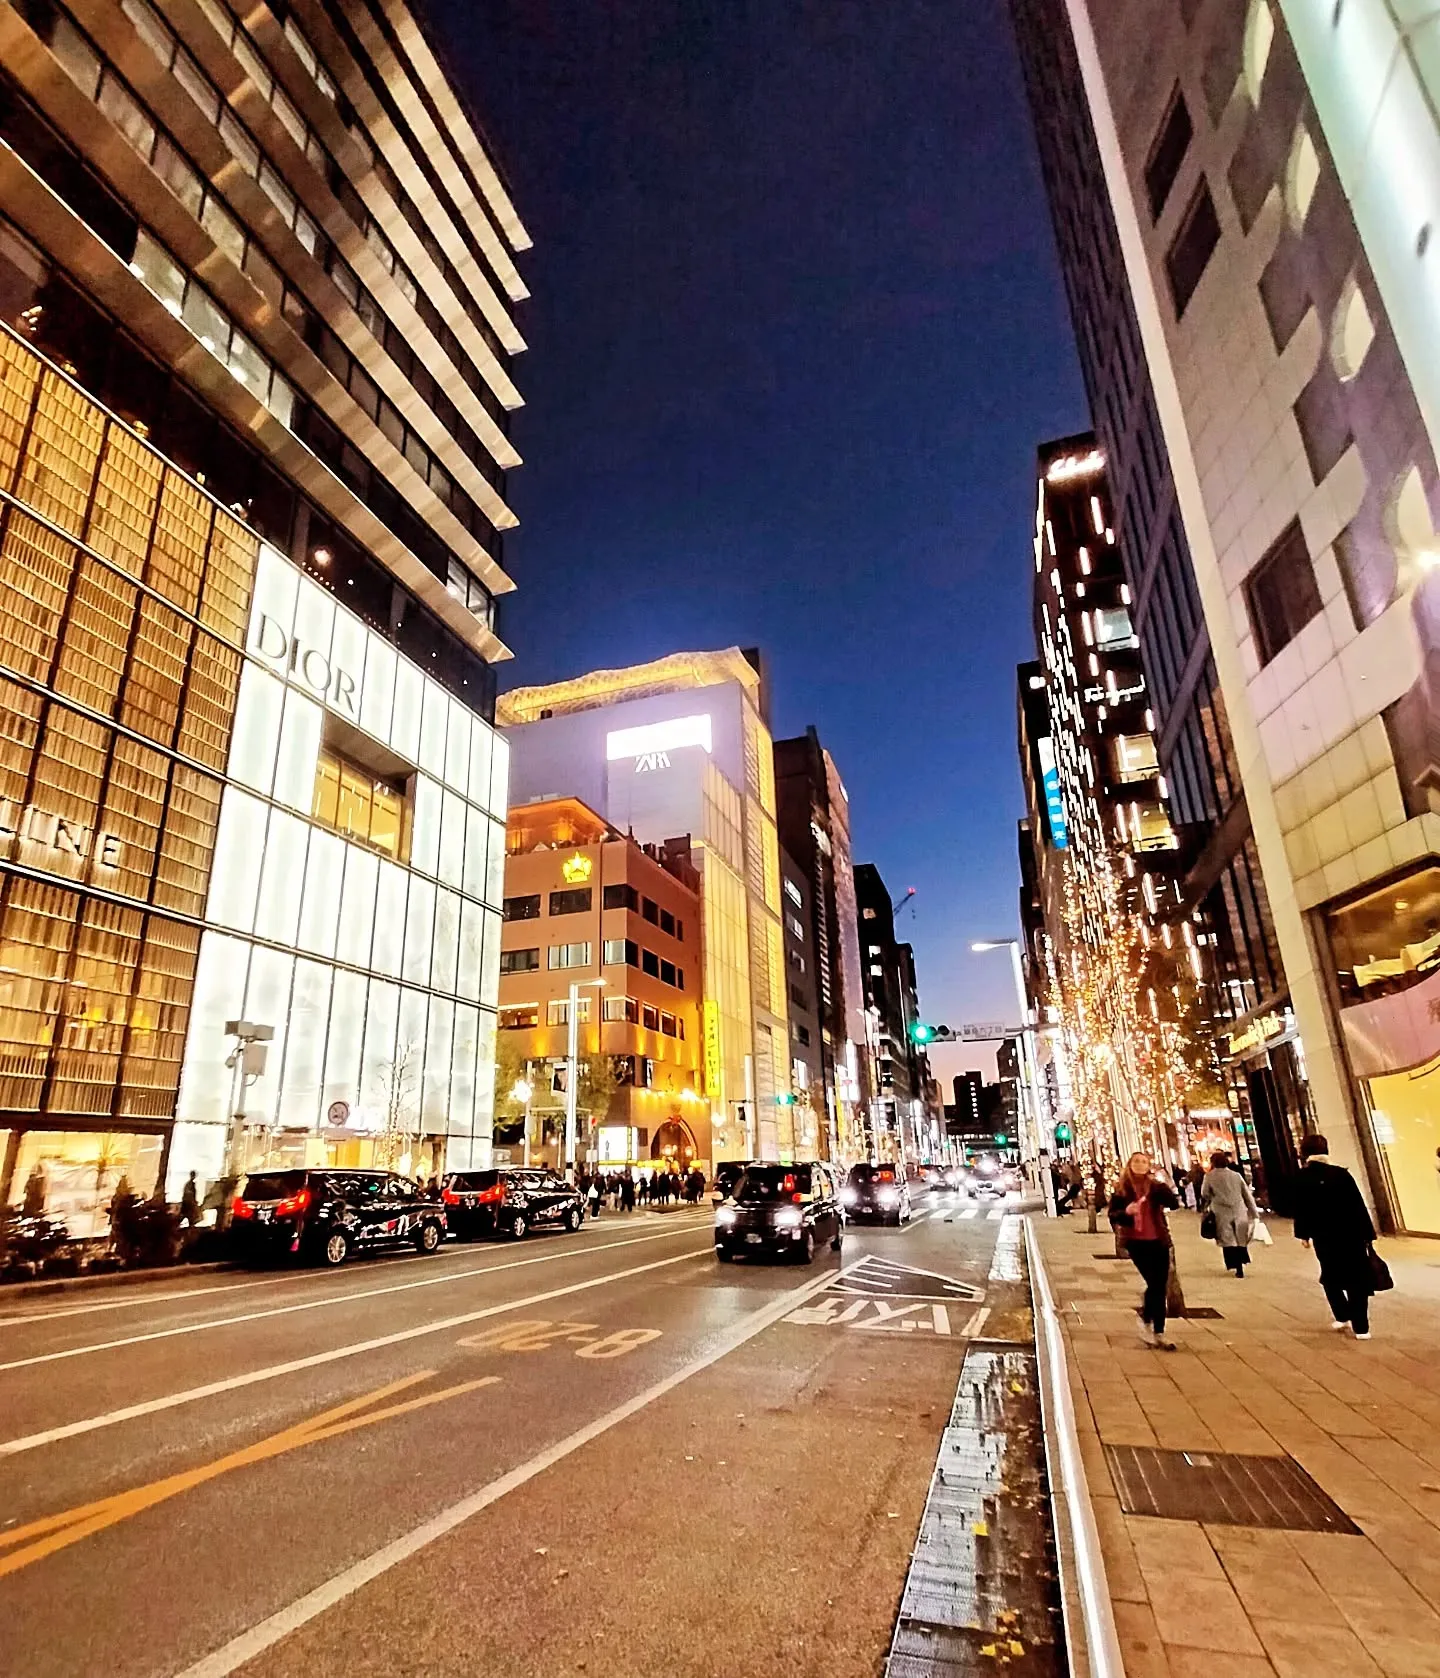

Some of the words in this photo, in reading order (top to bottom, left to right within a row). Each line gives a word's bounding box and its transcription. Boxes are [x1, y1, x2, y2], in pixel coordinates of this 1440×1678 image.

[255, 611, 356, 714] DIOR
[781, 1296, 991, 1338] バス停
[456, 1320, 663, 1358] 8-20
